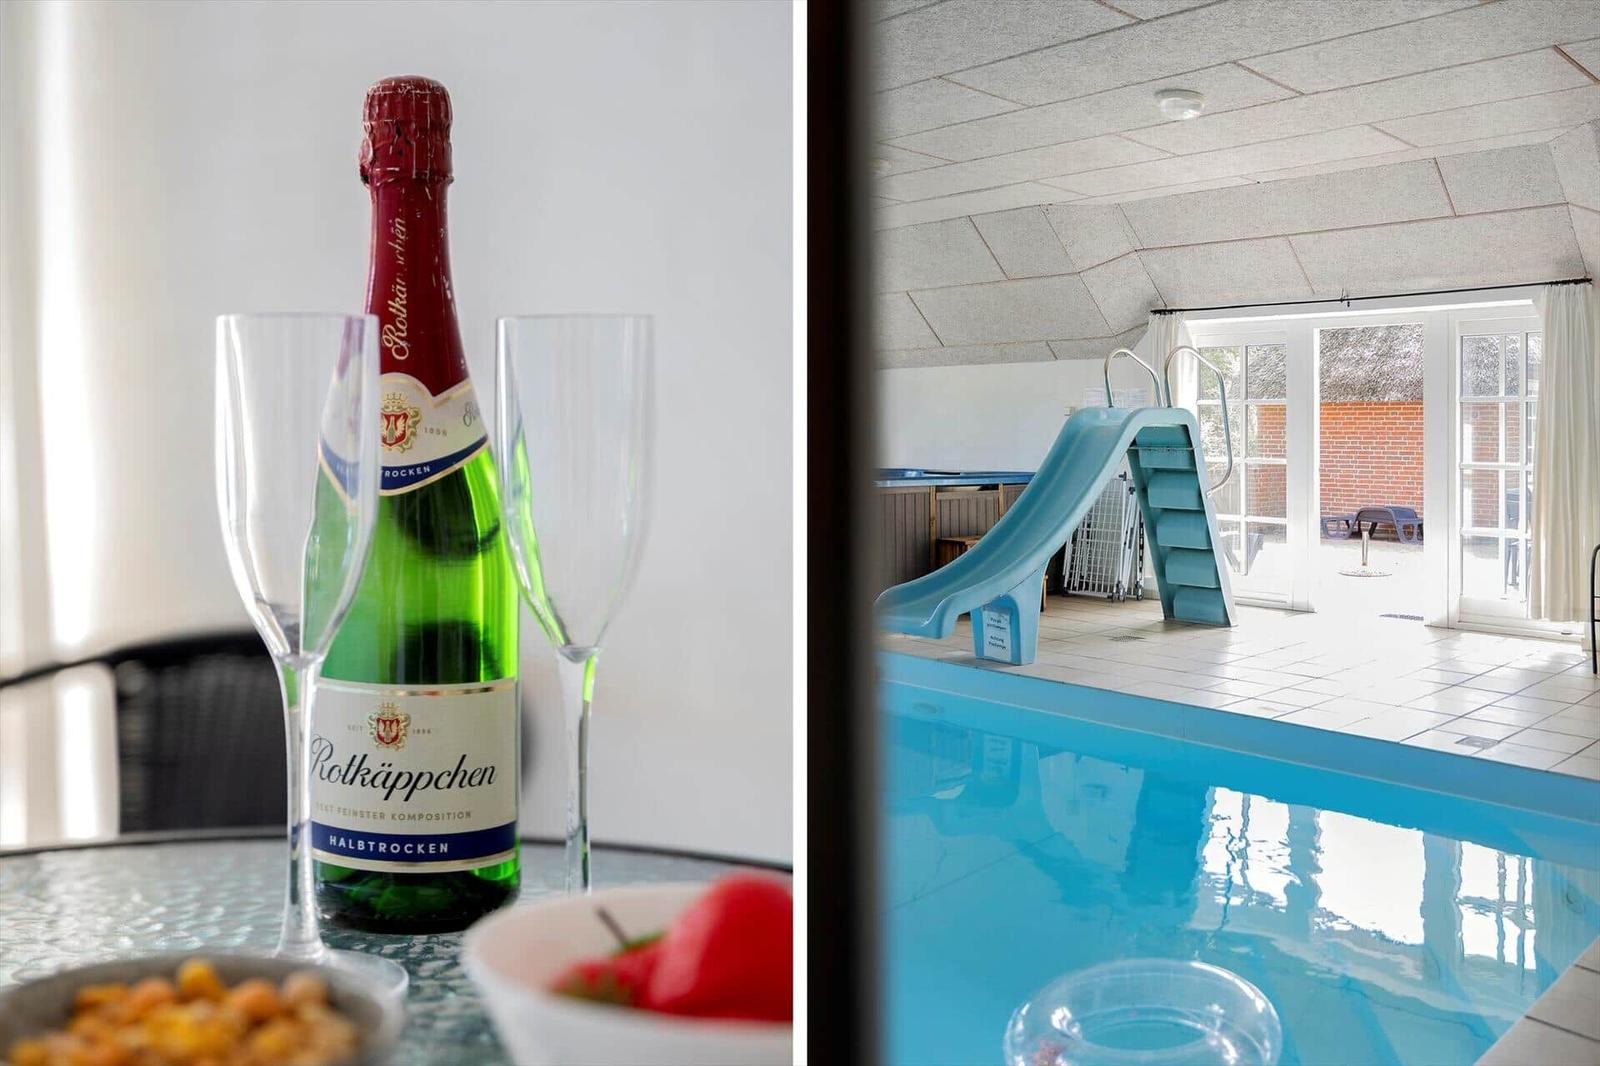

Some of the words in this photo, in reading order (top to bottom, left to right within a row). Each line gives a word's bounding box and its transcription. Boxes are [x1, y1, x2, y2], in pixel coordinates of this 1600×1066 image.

[381, 216, 410, 360] Rotkächen
[311, 733, 496, 802] Rotkäppchen
[337, 806, 385, 819] FEINSTER
[391, 811, 472, 821] KOMPOSITION
[329, 834, 449, 854] HALBTROCKEN
